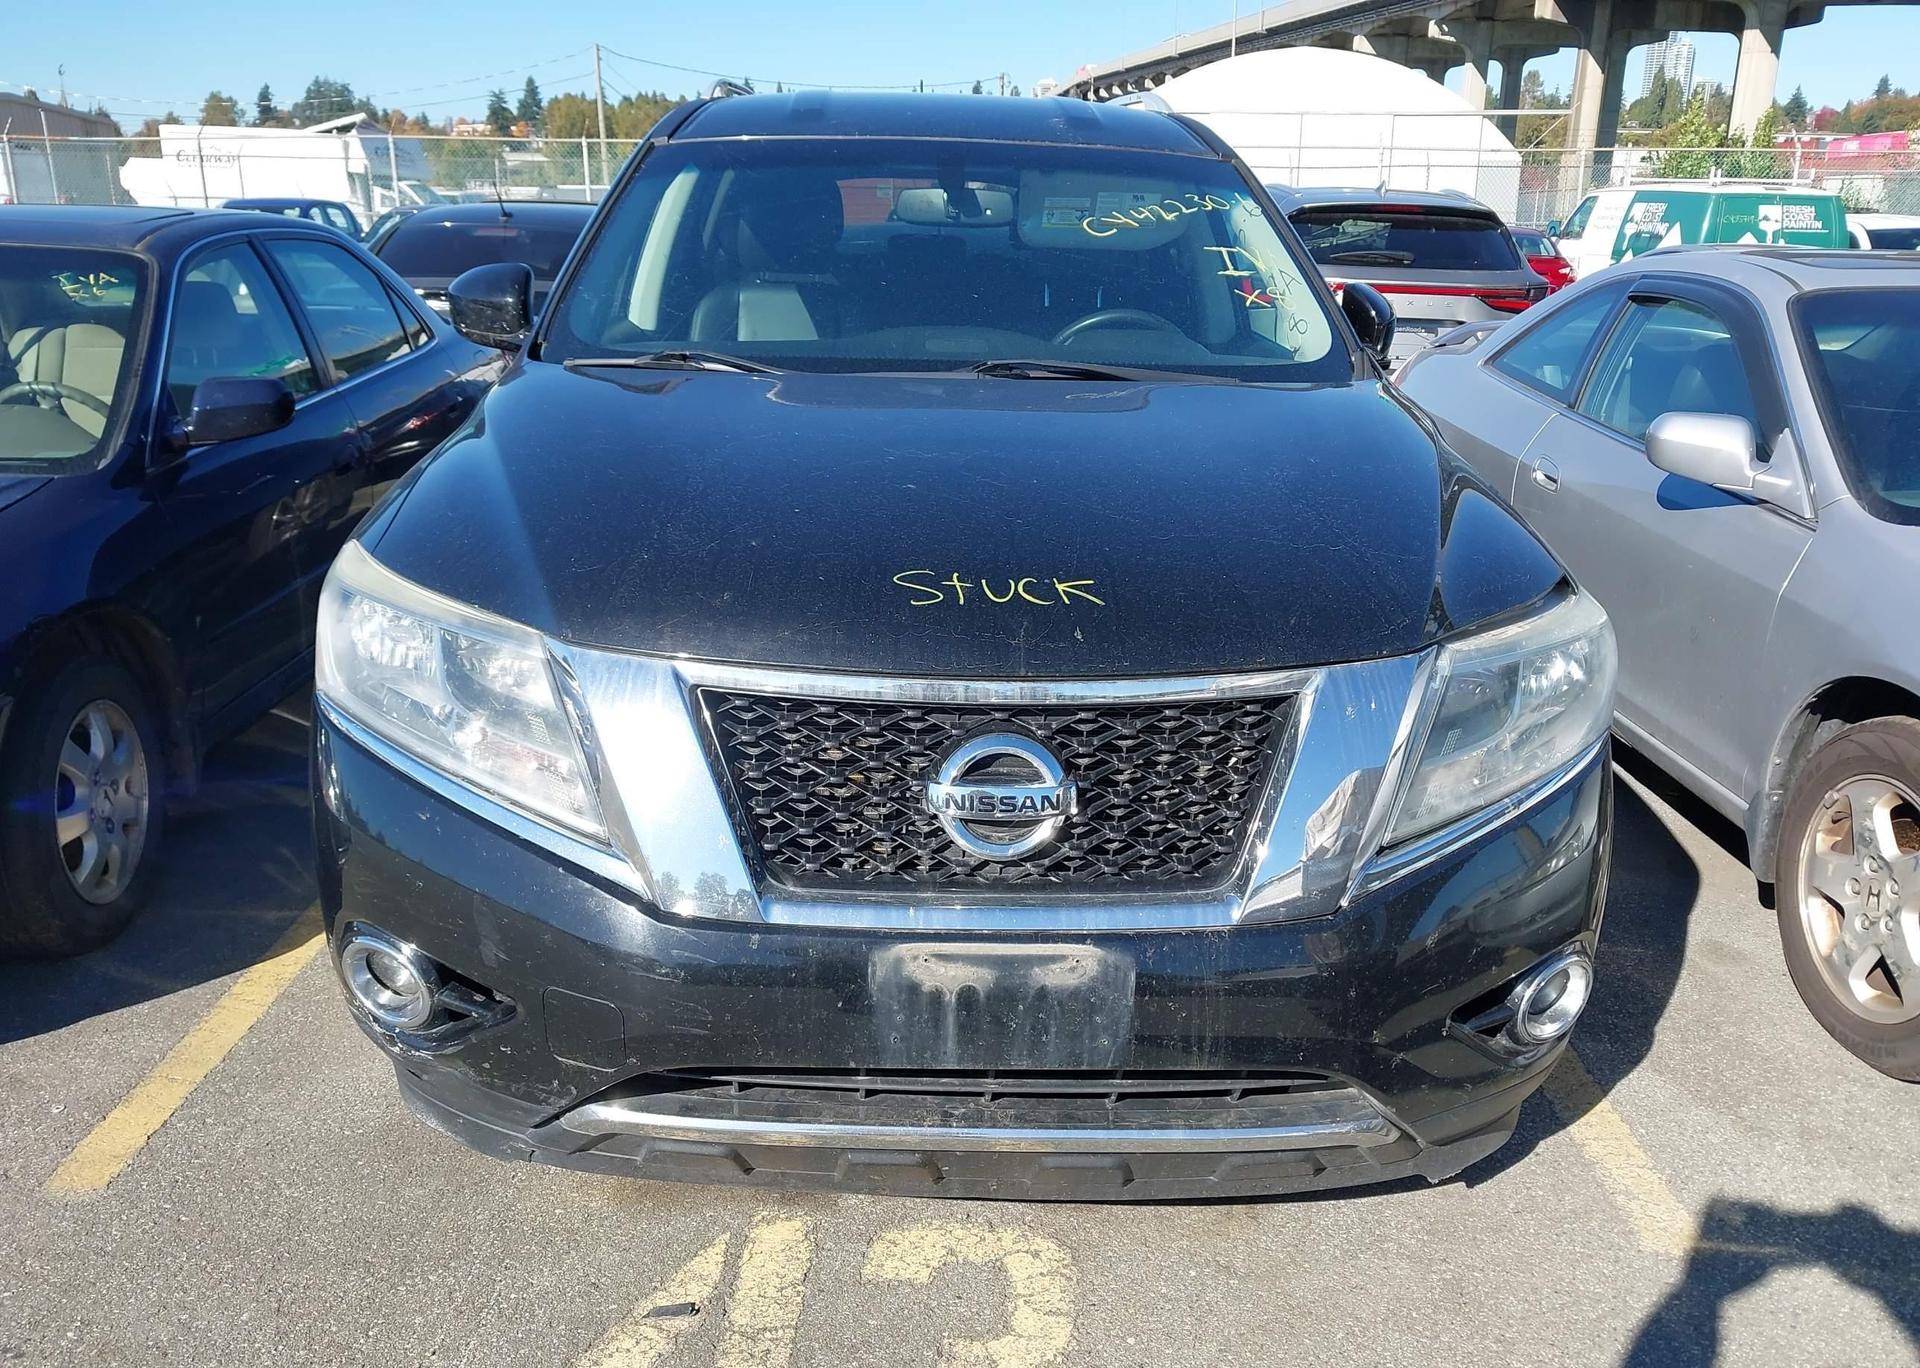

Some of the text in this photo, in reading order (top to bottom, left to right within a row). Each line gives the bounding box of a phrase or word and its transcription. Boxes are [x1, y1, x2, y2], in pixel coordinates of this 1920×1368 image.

[1783, 204, 1816, 213] FRESH
[1641, 212, 1665, 222] COST
[1782, 213, 1816, 221] COAST
[945, 793, 1061, 813] NISSAN
